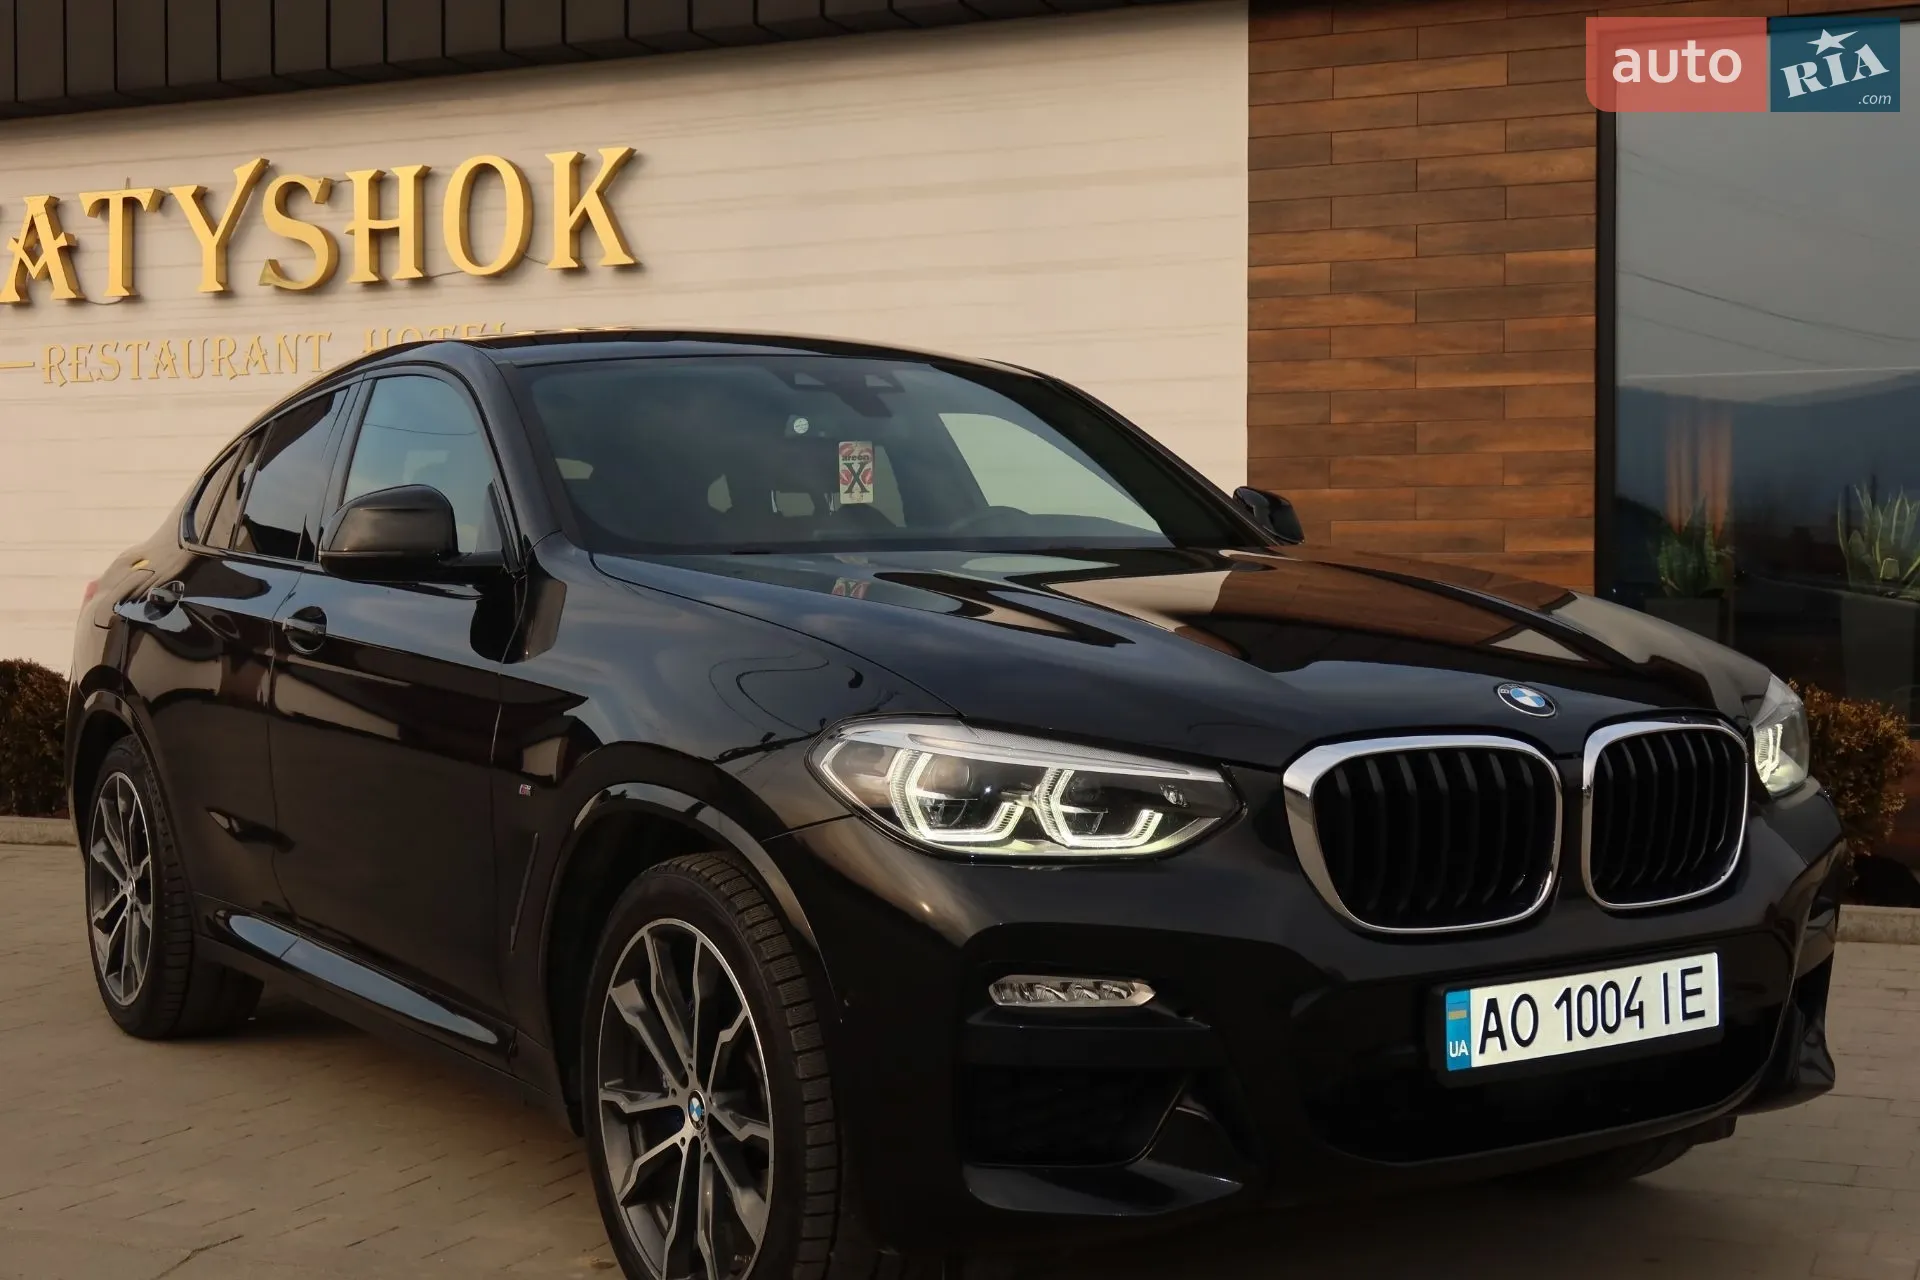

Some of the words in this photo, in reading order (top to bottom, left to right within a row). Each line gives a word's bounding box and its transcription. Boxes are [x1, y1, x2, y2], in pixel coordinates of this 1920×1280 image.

[41, 331, 332, 387] RESTAURANT
[842, 461, 870, 494] X
[1478, 993, 1539, 1055] AO
[1554, 976, 1645, 1041] 1004
[1663, 965, 1706, 1025] IE
[1449, 1041, 1469, 1058] UA
